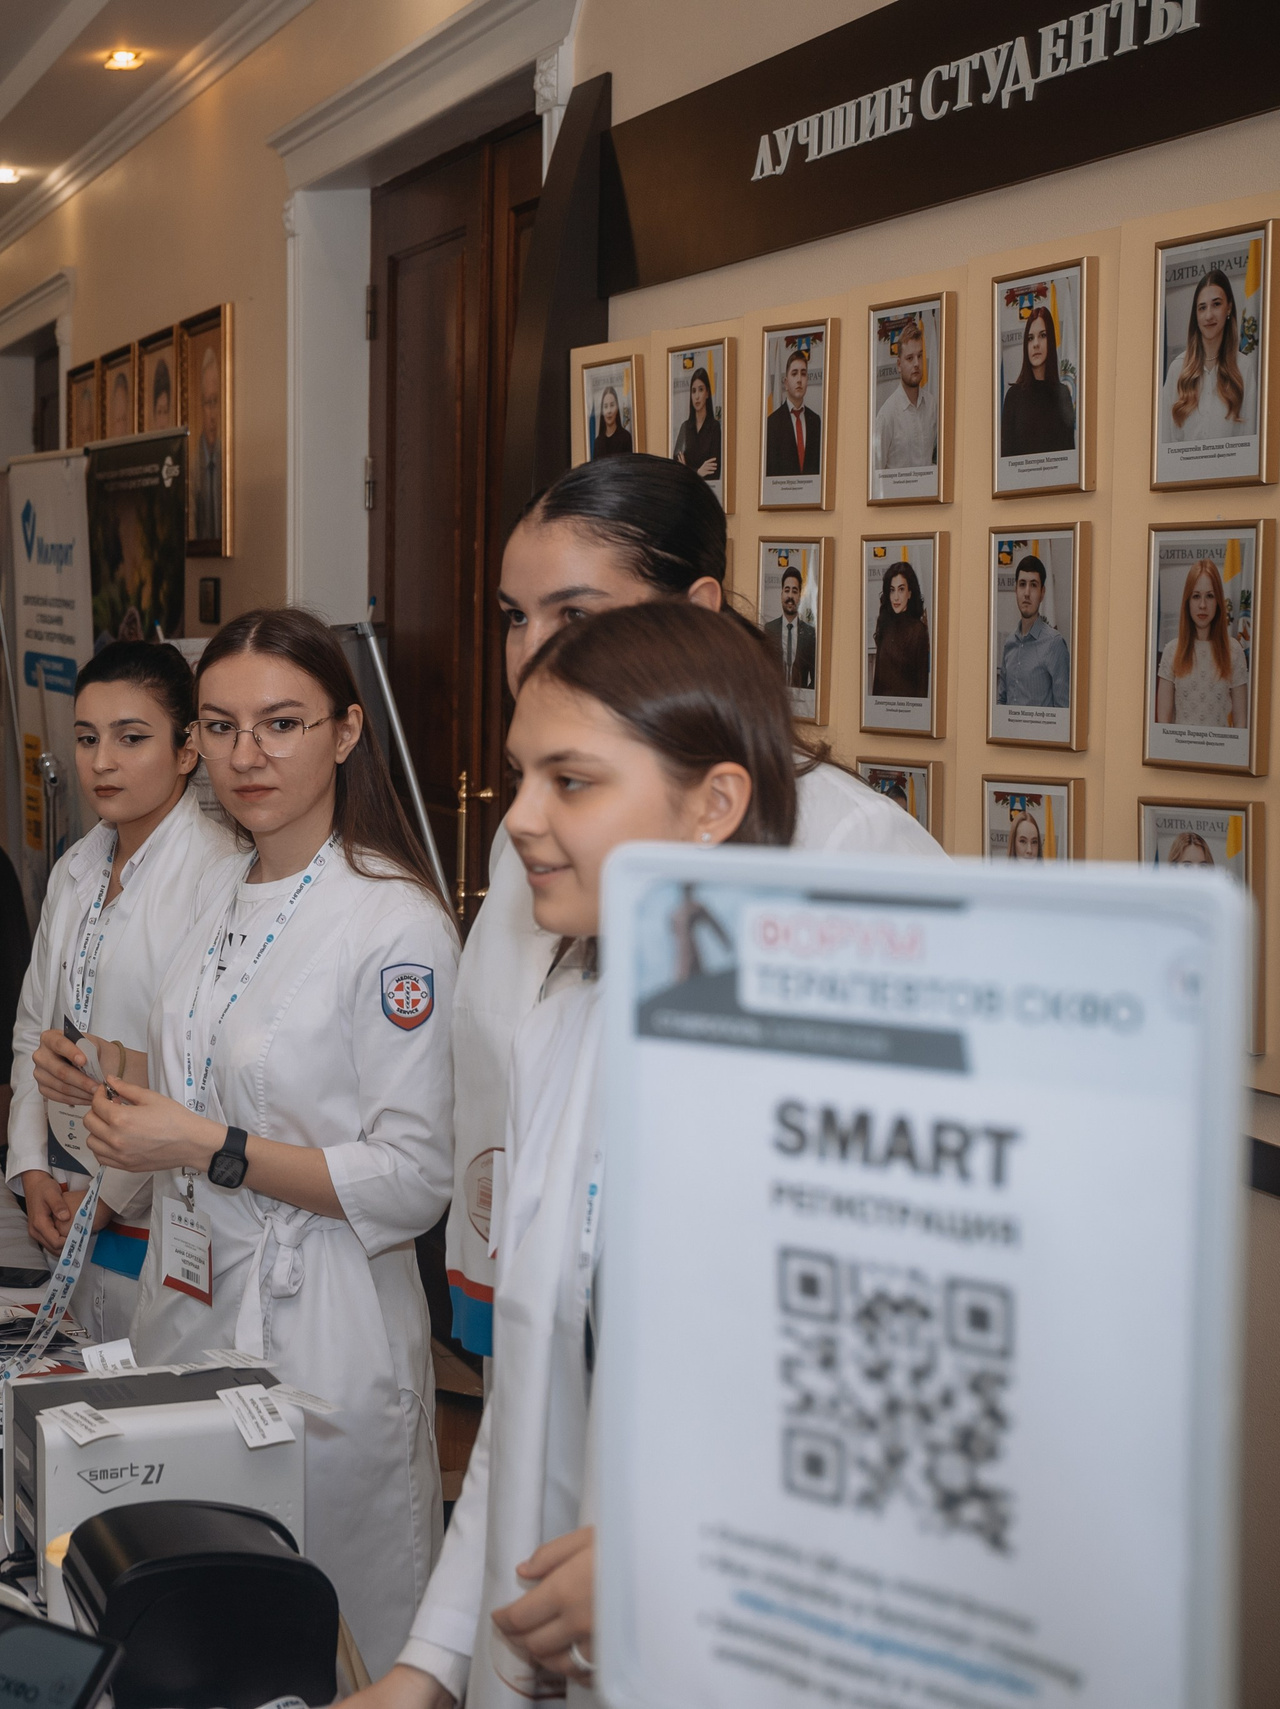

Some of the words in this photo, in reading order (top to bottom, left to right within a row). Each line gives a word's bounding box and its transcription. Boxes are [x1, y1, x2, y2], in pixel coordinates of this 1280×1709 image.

[751, 78, 913, 182] ЛУЧШИЕ
[920, 0, 1201, 121] СТУДЕНТЫ
[753, 912, 924, 962] ФОРУМ
[395, 975, 420, 984] MEDICAL
[754, 964, 1006, 1020] ТЕРАПЕВТОВ
[1009, 985, 1146, 1036] СКФО
[396, 1007, 419, 1015] SERVICE
[772, 1098, 1022, 1190] SMART
[772, 1181, 1021, 1248] РЕГИСТРАЦИЯ
[89, 1462, 139, 1481] smart
[140, 1463, 165, 1486] 21
